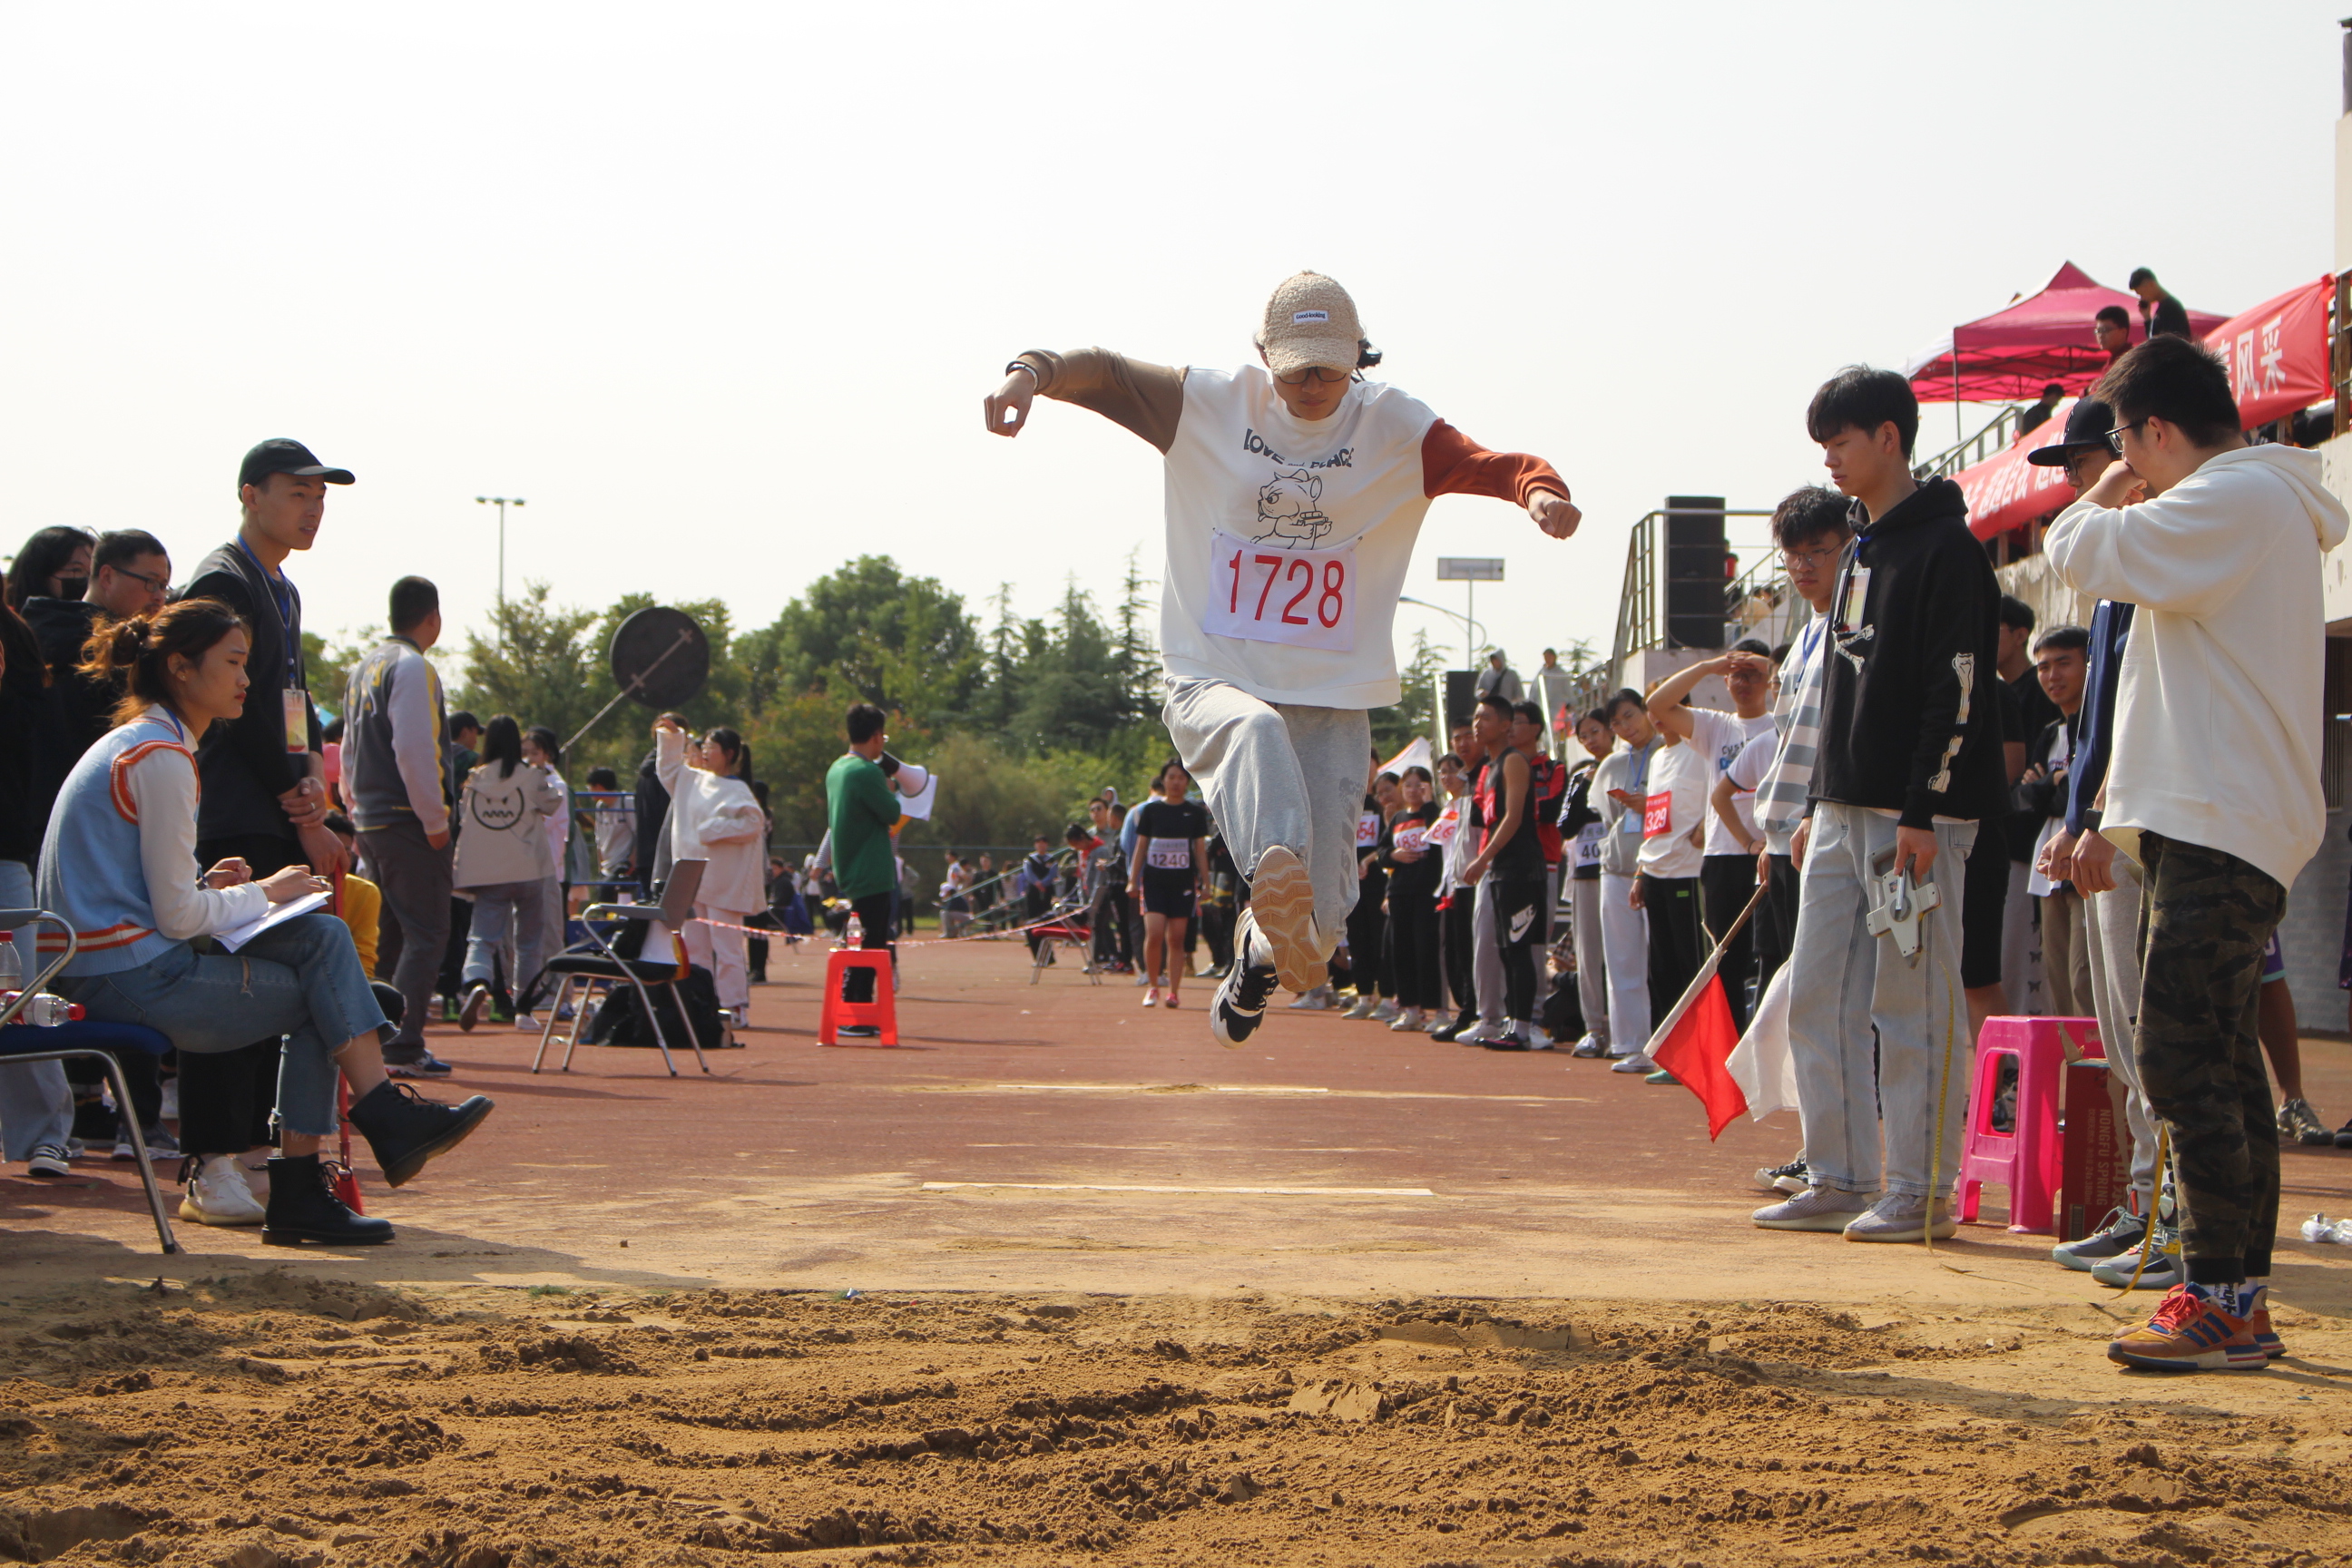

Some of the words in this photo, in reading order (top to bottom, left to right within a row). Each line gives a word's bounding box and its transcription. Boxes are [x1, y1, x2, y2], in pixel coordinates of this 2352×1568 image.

[1243, 428, 1286, 465] LOVE
[1230, 550, 1345, 629] 1728
[1152, 854, 1188, 867] 1240
[2098, 1108, 2112, 1157] NONGFU
[2096, 1161, 2110, 1206] SPRING
